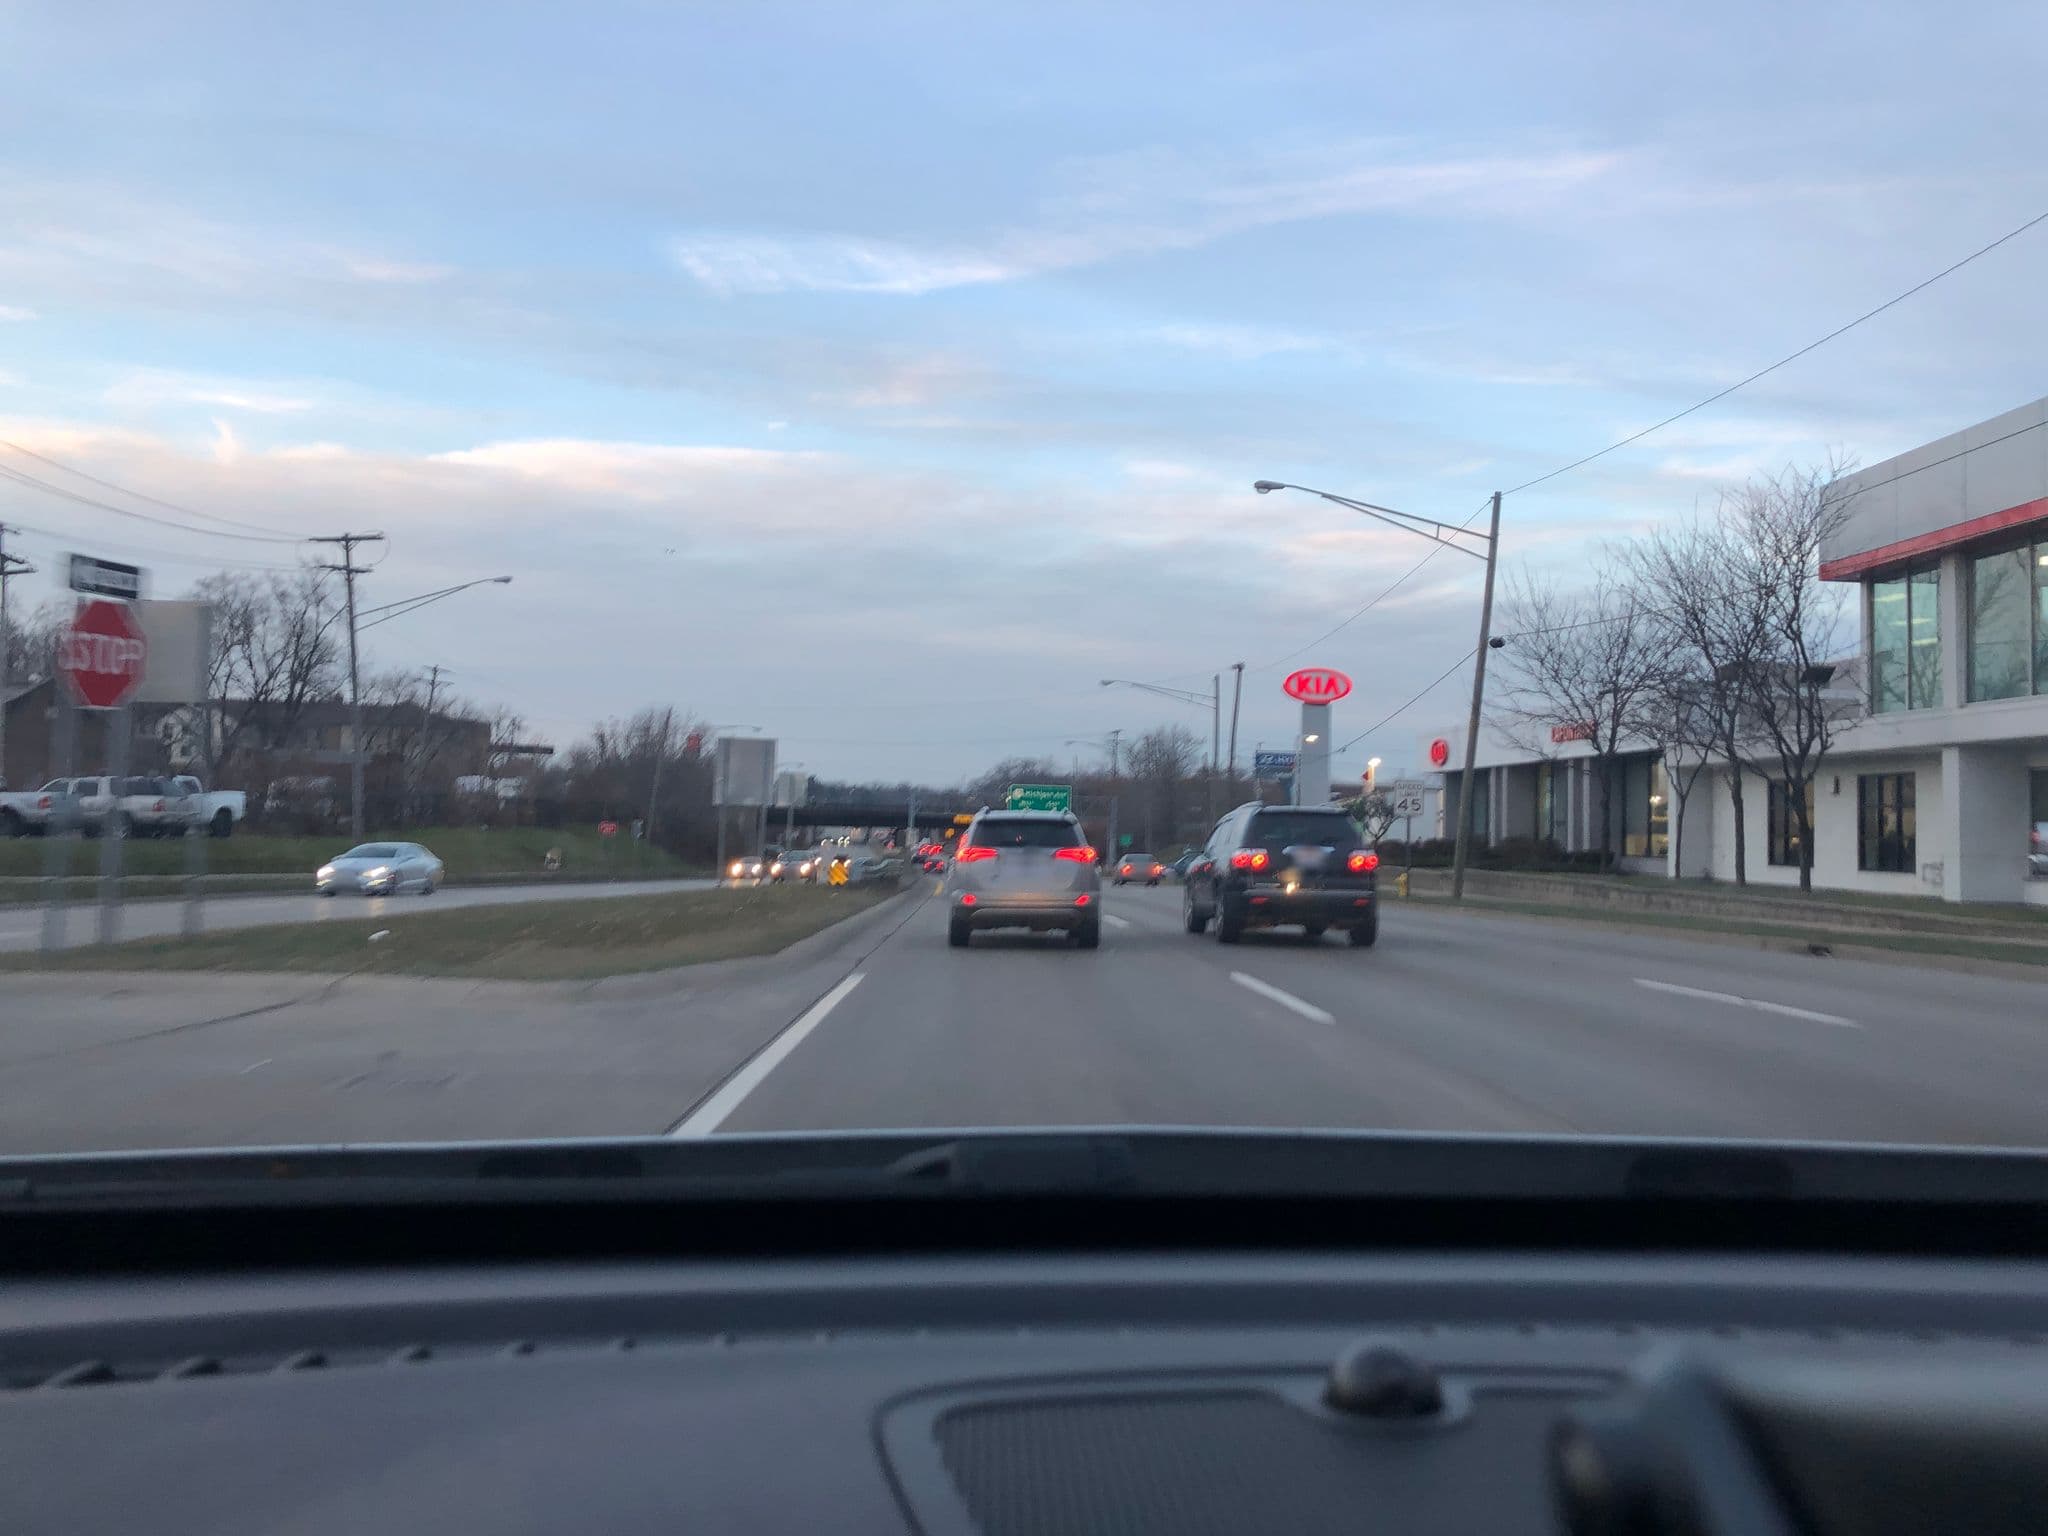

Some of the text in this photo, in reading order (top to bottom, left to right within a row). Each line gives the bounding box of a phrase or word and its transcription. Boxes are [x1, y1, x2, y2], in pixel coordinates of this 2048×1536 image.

[59, 631, 145, 675] STOP
[1297, 676, 1340, 695] KIA
[1398, 798, 1421, 811] 45
